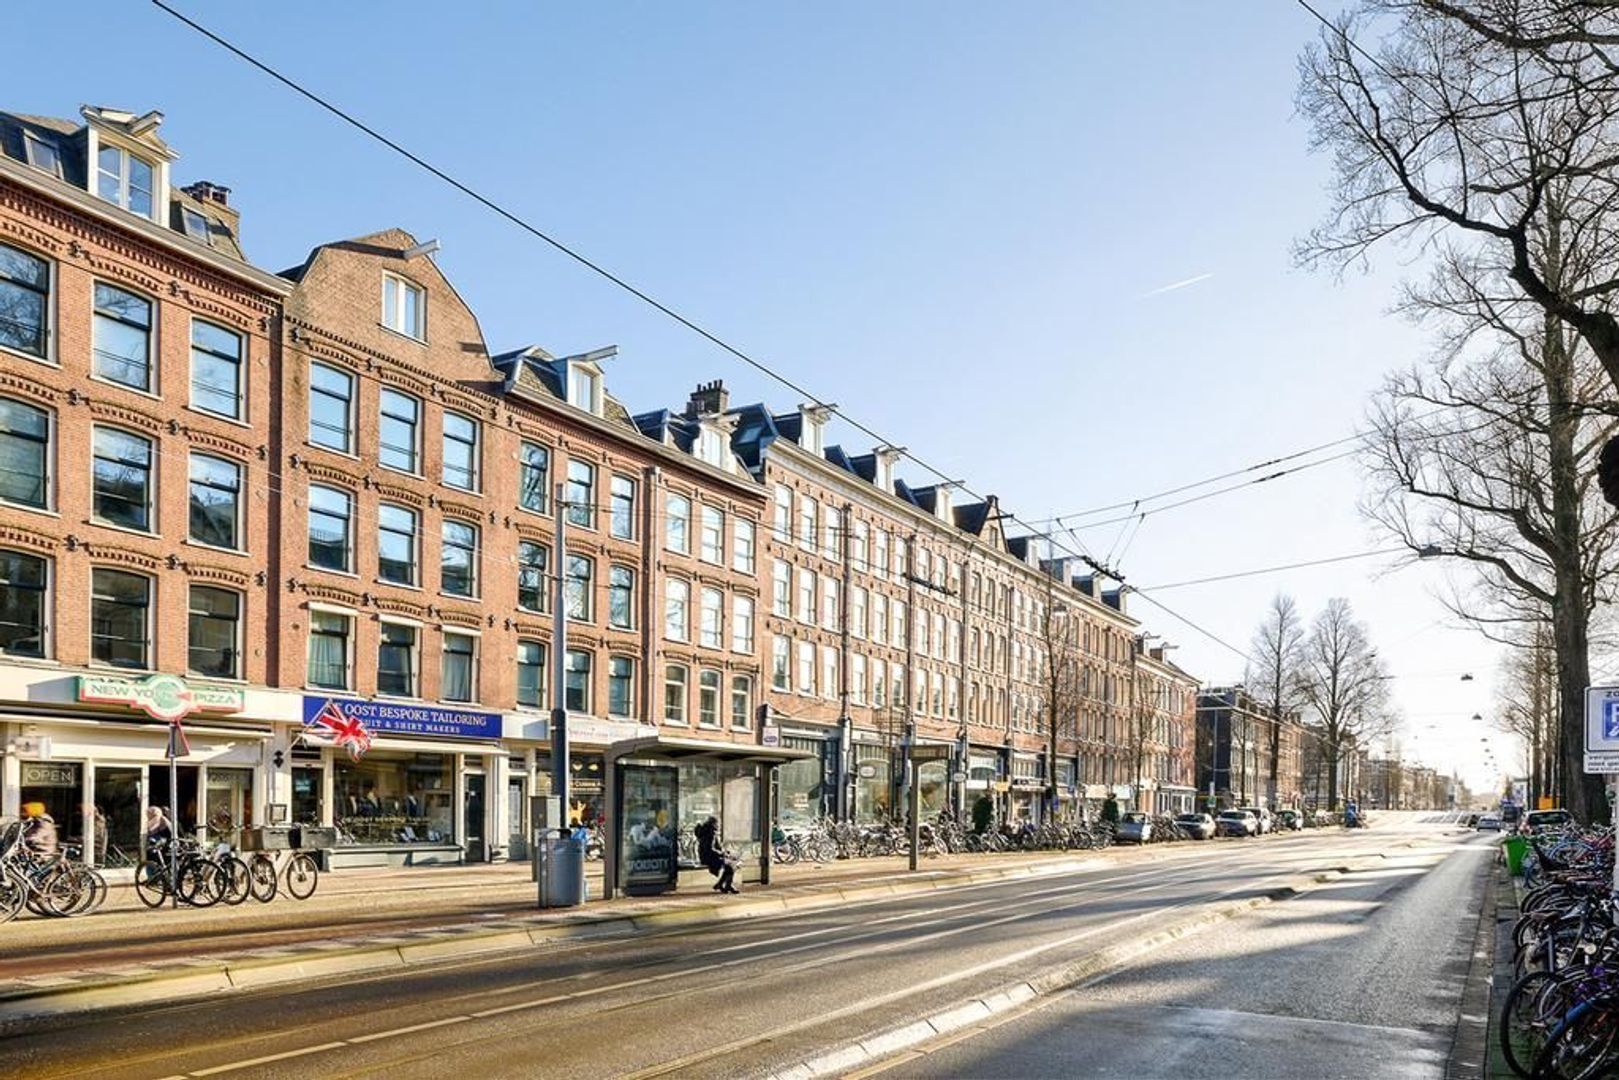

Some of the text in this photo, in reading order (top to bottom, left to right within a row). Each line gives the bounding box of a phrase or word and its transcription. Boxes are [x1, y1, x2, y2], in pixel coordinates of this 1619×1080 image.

[91, 683, 129, 696] NEW
[194, 692, 236, 704] PIZZA
[344, 703, 377, 717] OOST
[380, 707, 429, 722] BESPOKE
[430, 711, 487, 727] TAILORING
[425, 723, 460, 734] MAKERS
[28, 768, 72, 782] OPEN
